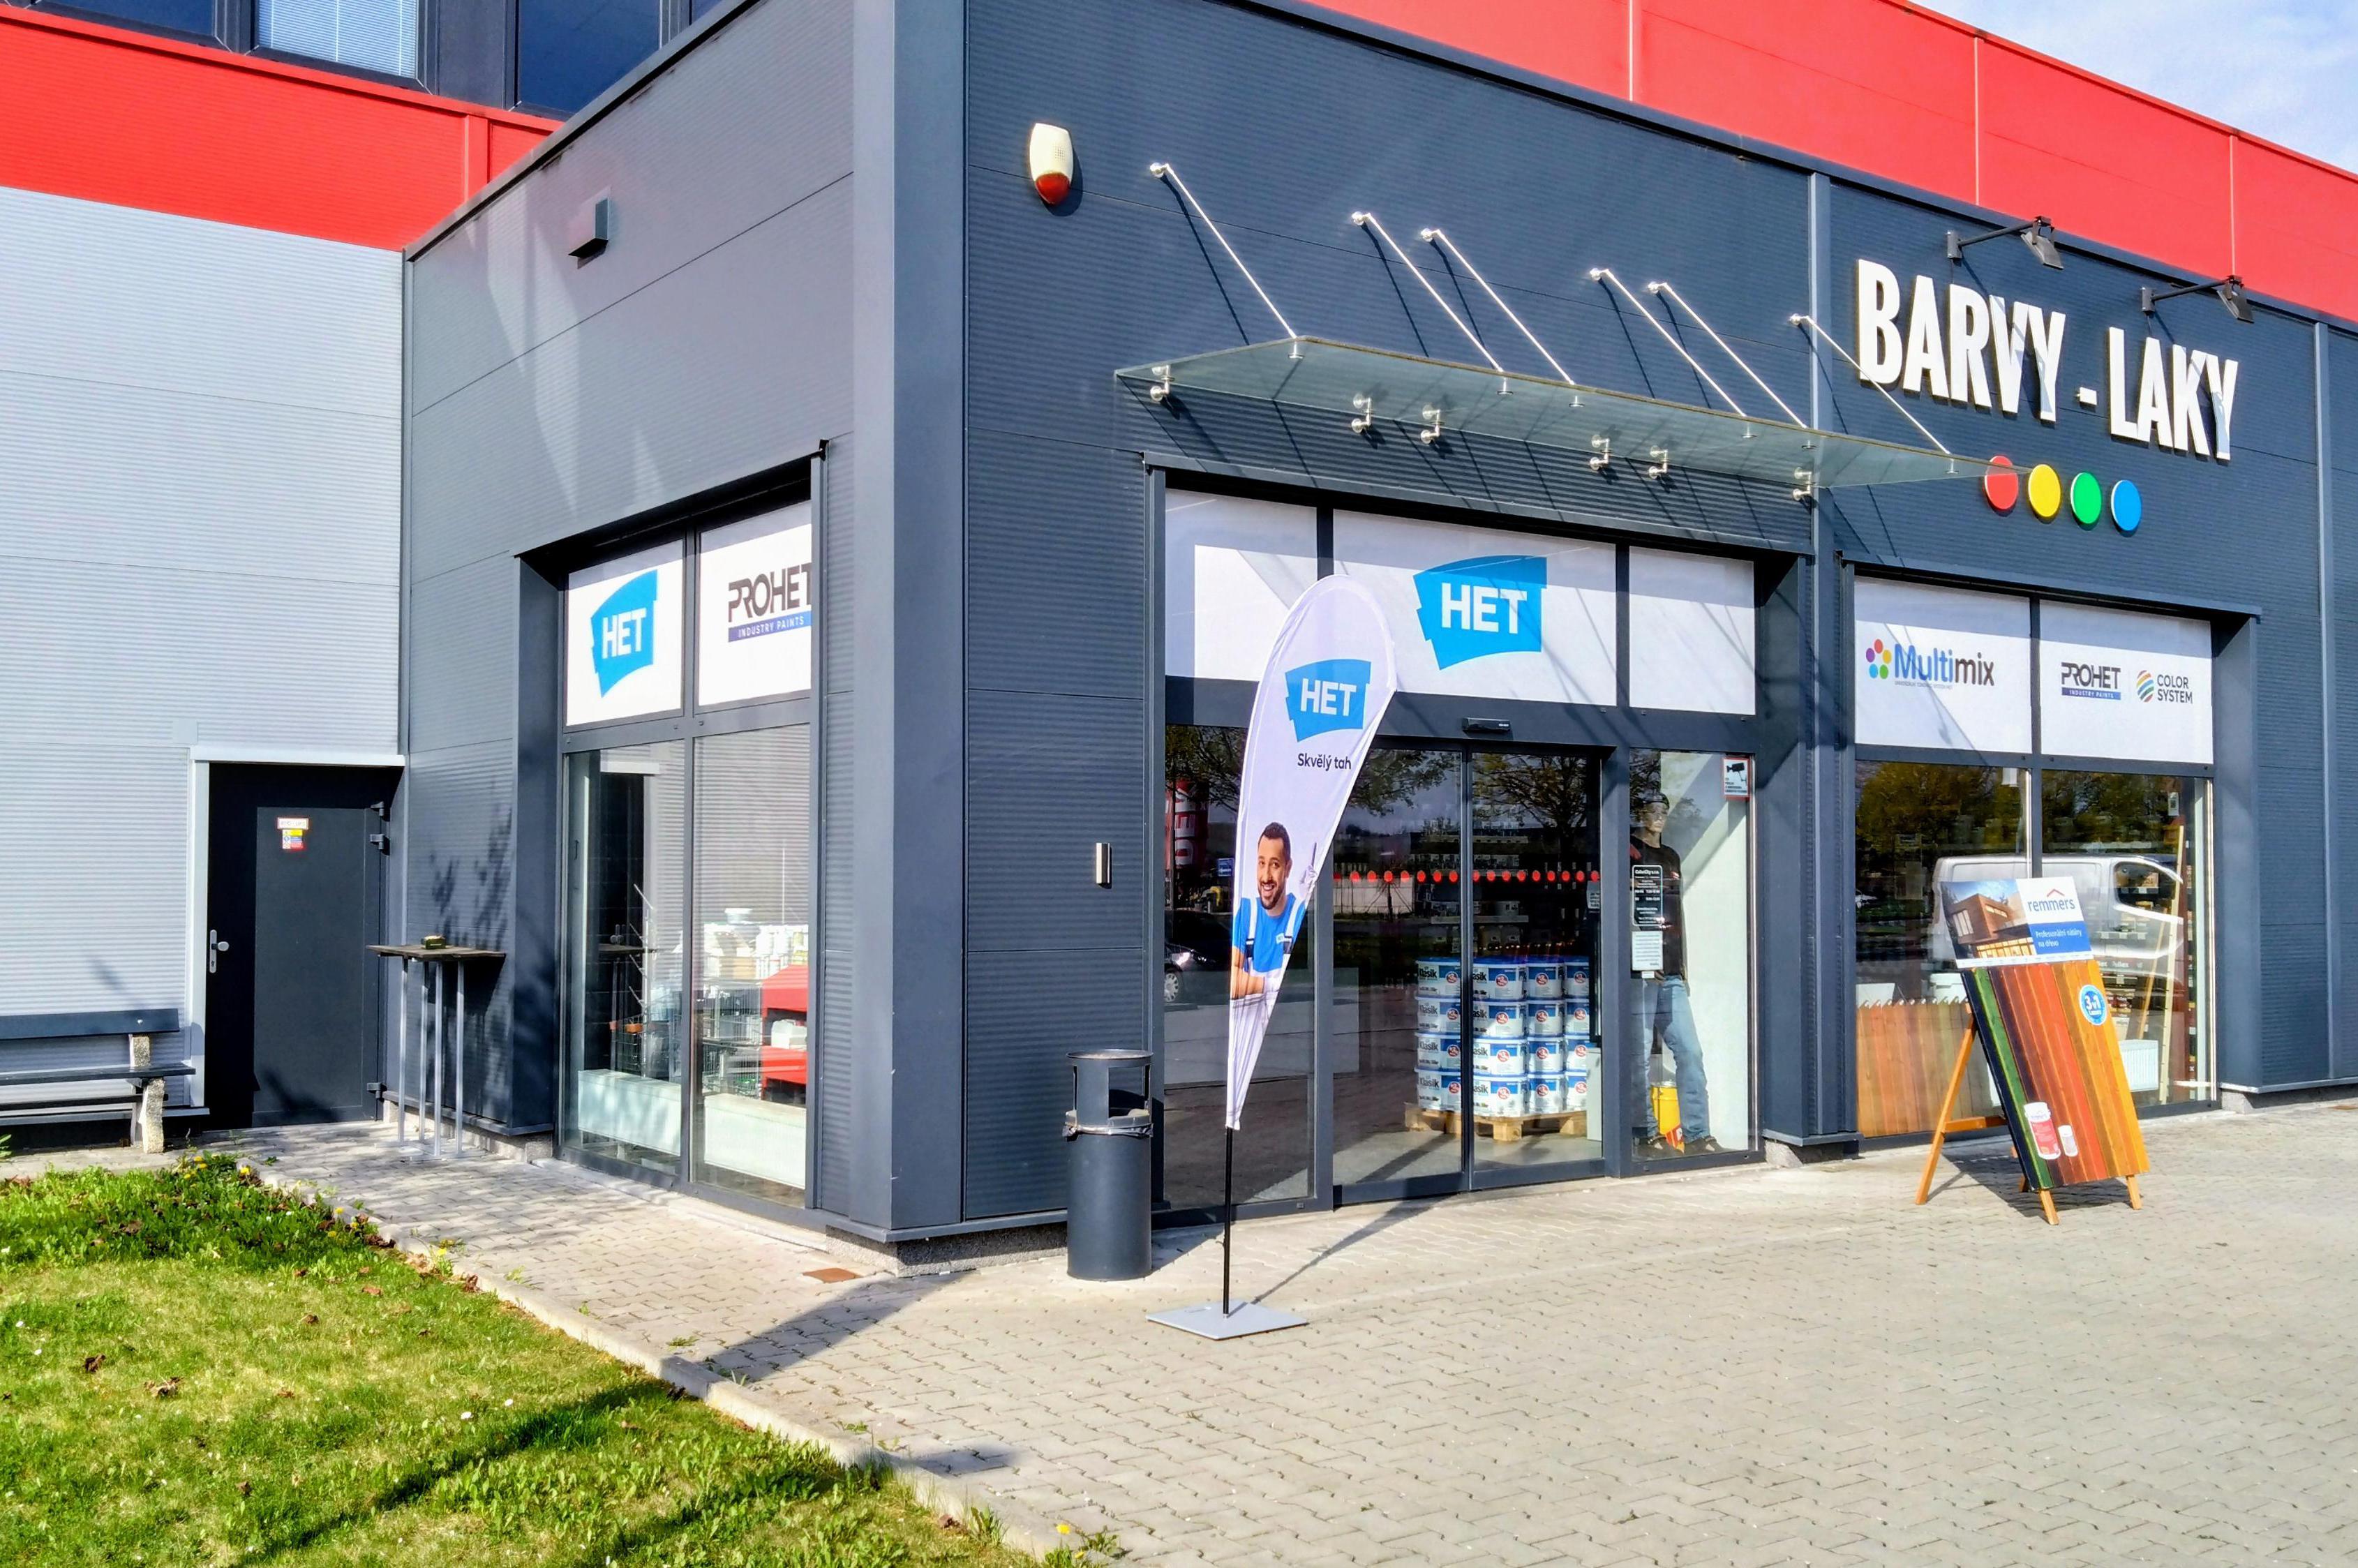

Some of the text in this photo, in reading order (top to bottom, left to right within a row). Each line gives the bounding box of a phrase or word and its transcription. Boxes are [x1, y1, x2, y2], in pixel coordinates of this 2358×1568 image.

[1857, 259, 2066, 422] BARVY
[2107, 326, 2239, 461] LAKY
[728, 562, 812, 622] PROHET
[1442, 582, 1527, 634] HET
[601, 608, 647, 659] HET
[738, 615, 804, 638] INDUSTRY PAINTS
[1894, 643, 1994, 687] Multimix
[2061, 662, 2121, 689] PROHET
[2069, 689, 2095, 697] INDUSTRY
[2156, 674, 2189, 689] COLOR
[1300, 678, 1357, 717] HET
[2157, 689, 2193, 704] SYSTEM
[1297, 752, 1352, 772] Skvělý tah
[2027, 898, 2075, 912] remmers
